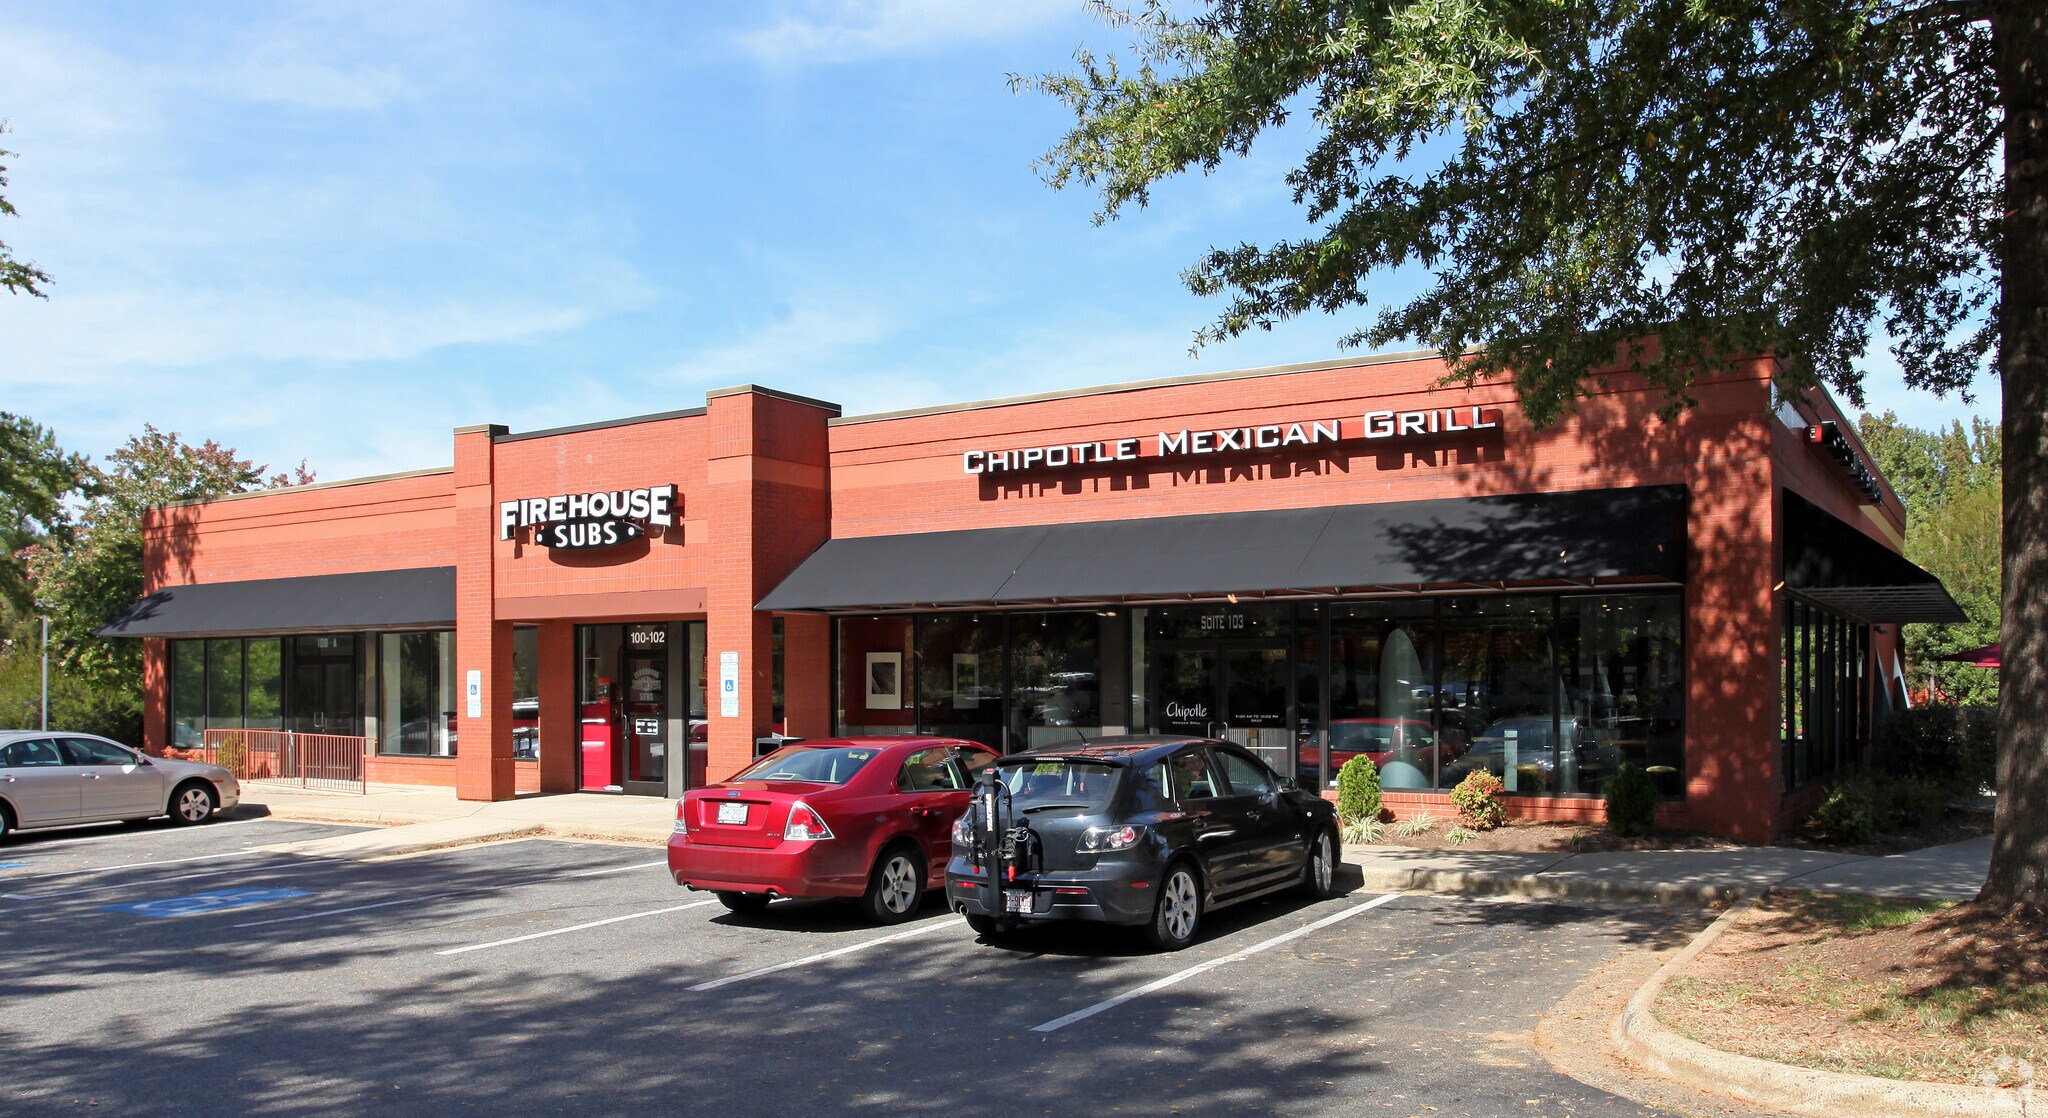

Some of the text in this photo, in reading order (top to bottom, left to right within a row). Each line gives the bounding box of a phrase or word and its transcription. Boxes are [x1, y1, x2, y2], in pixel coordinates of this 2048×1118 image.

[963, 406, 1497, 474] CHIPOTLE MEXICAN GRILL
[500, 484, 674, 541] FIREHOUSE
[555, 521, 618, 548] SUBS
[1201, 614, 1244, 630] SUITE 103
[631, 631, 665, 643] 100-102
[1166, 701, 1208, 722] Chipotle
